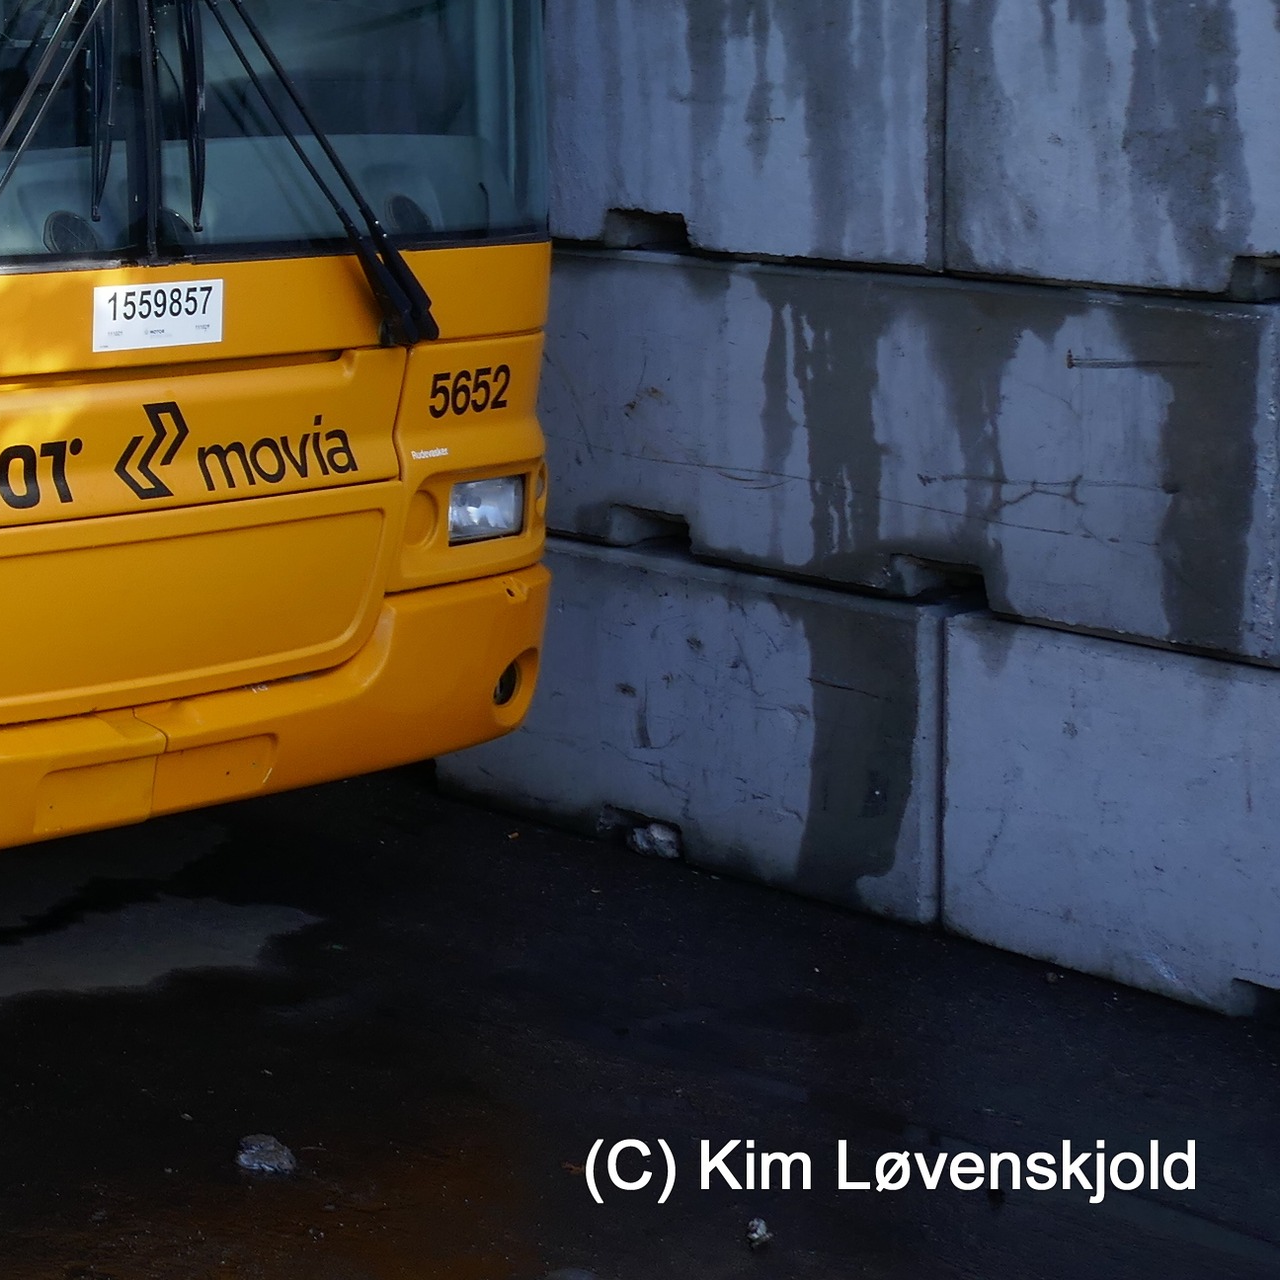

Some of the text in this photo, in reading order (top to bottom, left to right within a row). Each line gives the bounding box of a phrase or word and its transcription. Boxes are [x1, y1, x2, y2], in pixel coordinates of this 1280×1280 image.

[108, 286, 213, 321] 1559857
[429, 364, 511, 419] 5652
[197, 415, 359, 491] movia
